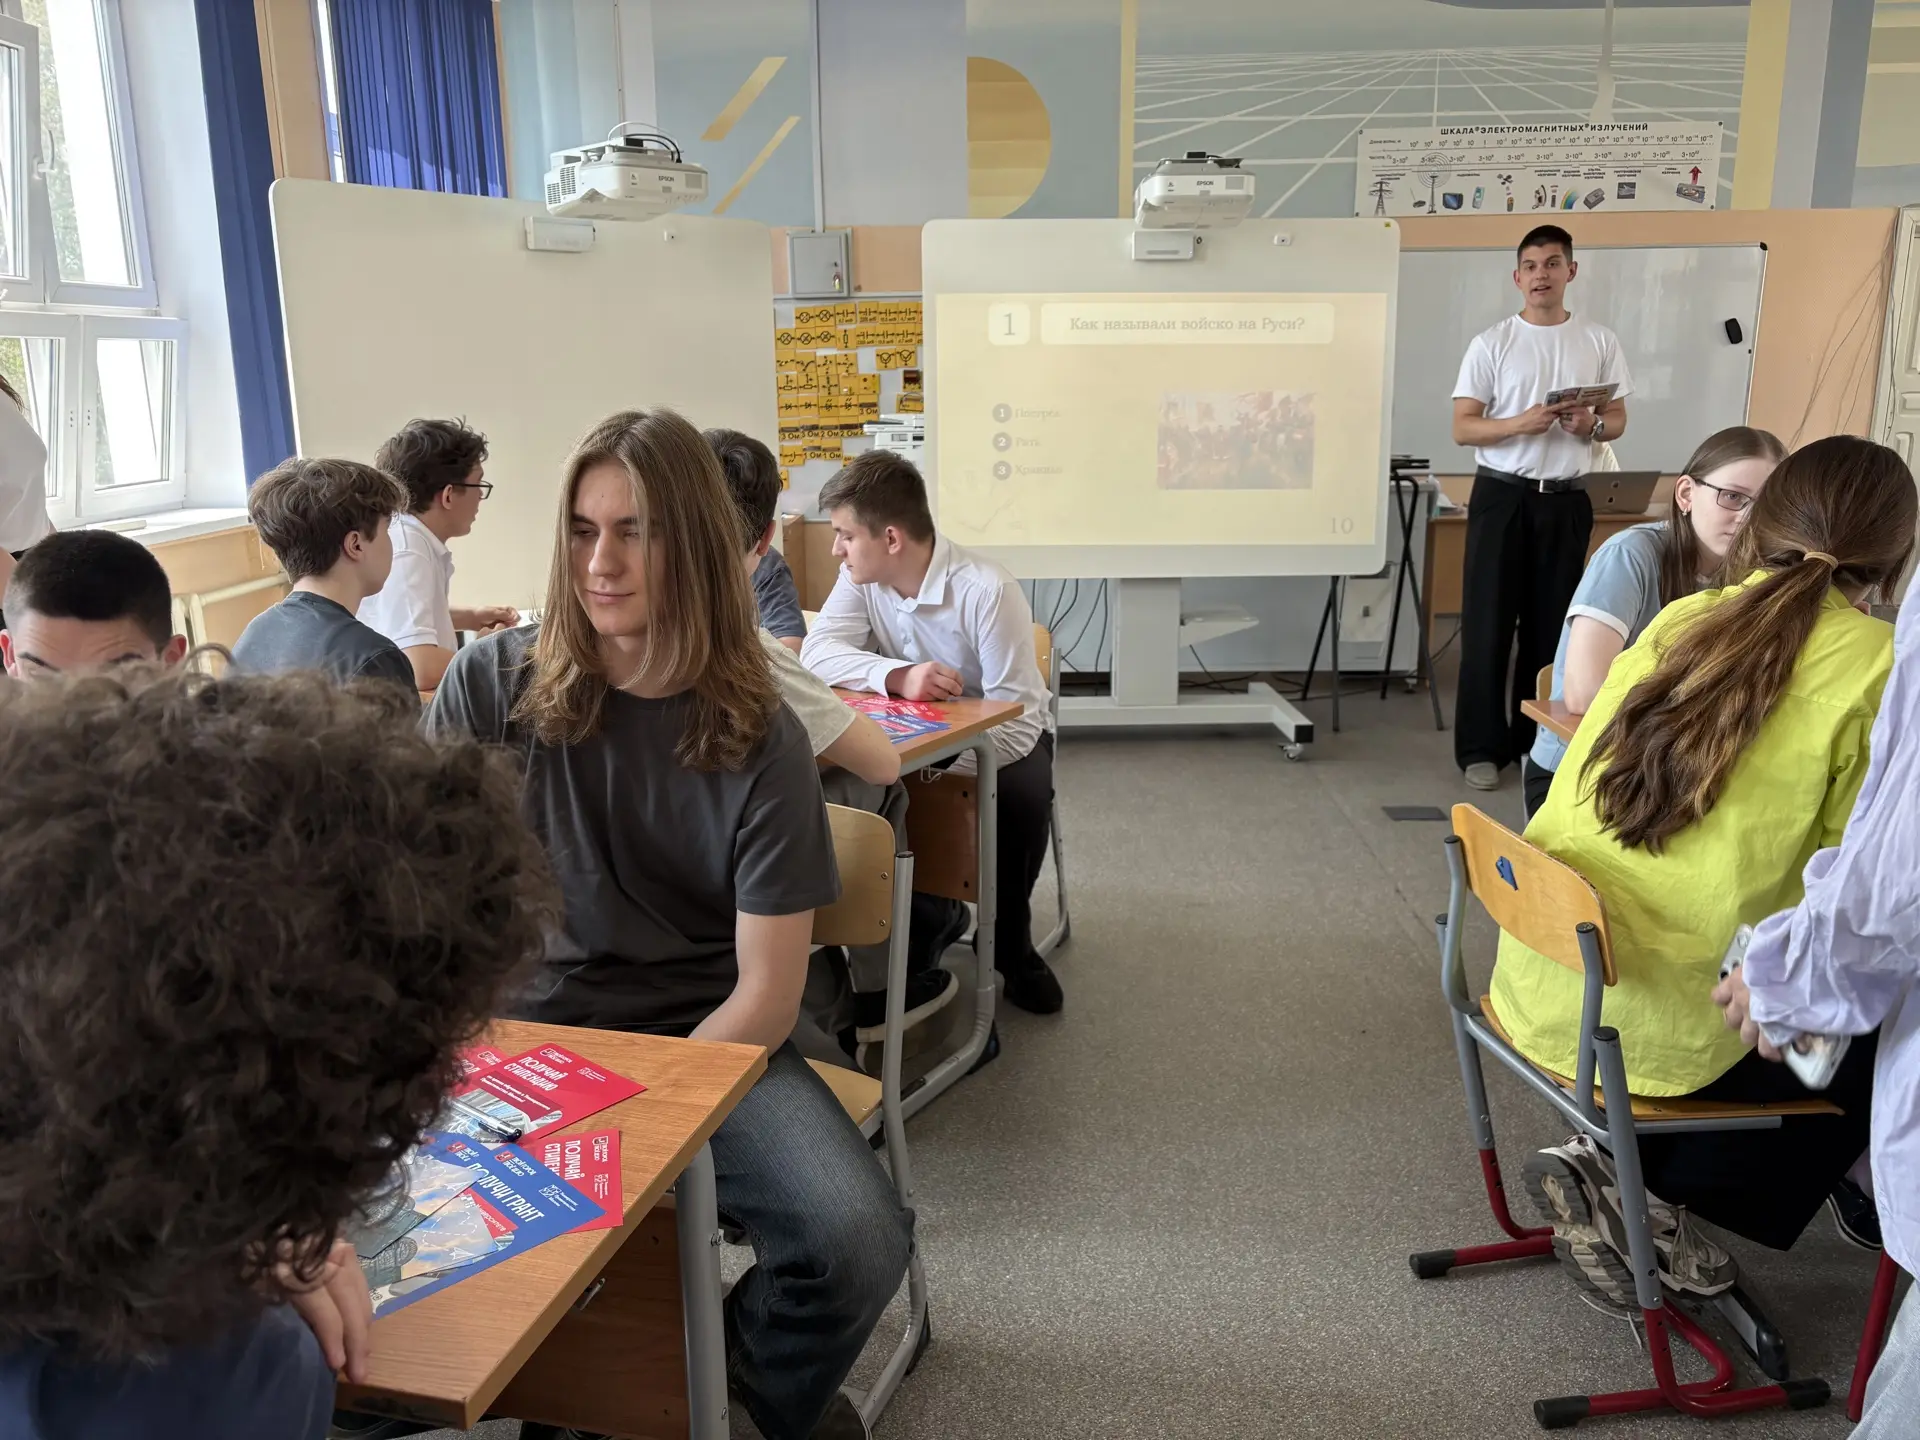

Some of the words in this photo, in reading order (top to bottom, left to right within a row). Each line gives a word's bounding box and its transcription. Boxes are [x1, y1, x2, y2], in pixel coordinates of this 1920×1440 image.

[1440, 127, 1474, 135] ШКАЛА
[1480, 124, 1584, 134] ЭЛЕКТРОМАГНИТНЫХ
[1590, 123, 1648, 132] ИЗЛУЧЕНИЙ
[1003, 313, 1016, 336] 1
[1070, 318, 1099, 331] Как
[1104, 318, 1176, 330] называли
[1181, 317, 1234, 330] войско
[1238, 320, 1256, 330] на
[1262, 317, 1305, 332] Руси?
[998, 437, 1006, 446] 2
[998, 466, 1006, 475] 3
[1329, 518, 1353, 534] 10
[504, 1063, 559, 1091] СТИПЕНДИЮ
[518, 1056, 568, 1081] ПОЛУЧАЙ
[544, 1143, 561, 1176] СТИПЕН
[564, 1140, 585, 1180] ПОЛУЧАЙ
[467, 1162, 514, 1199] ПОЛУЧИ
[501, 1194, 545, 1222] ГРАНТ
